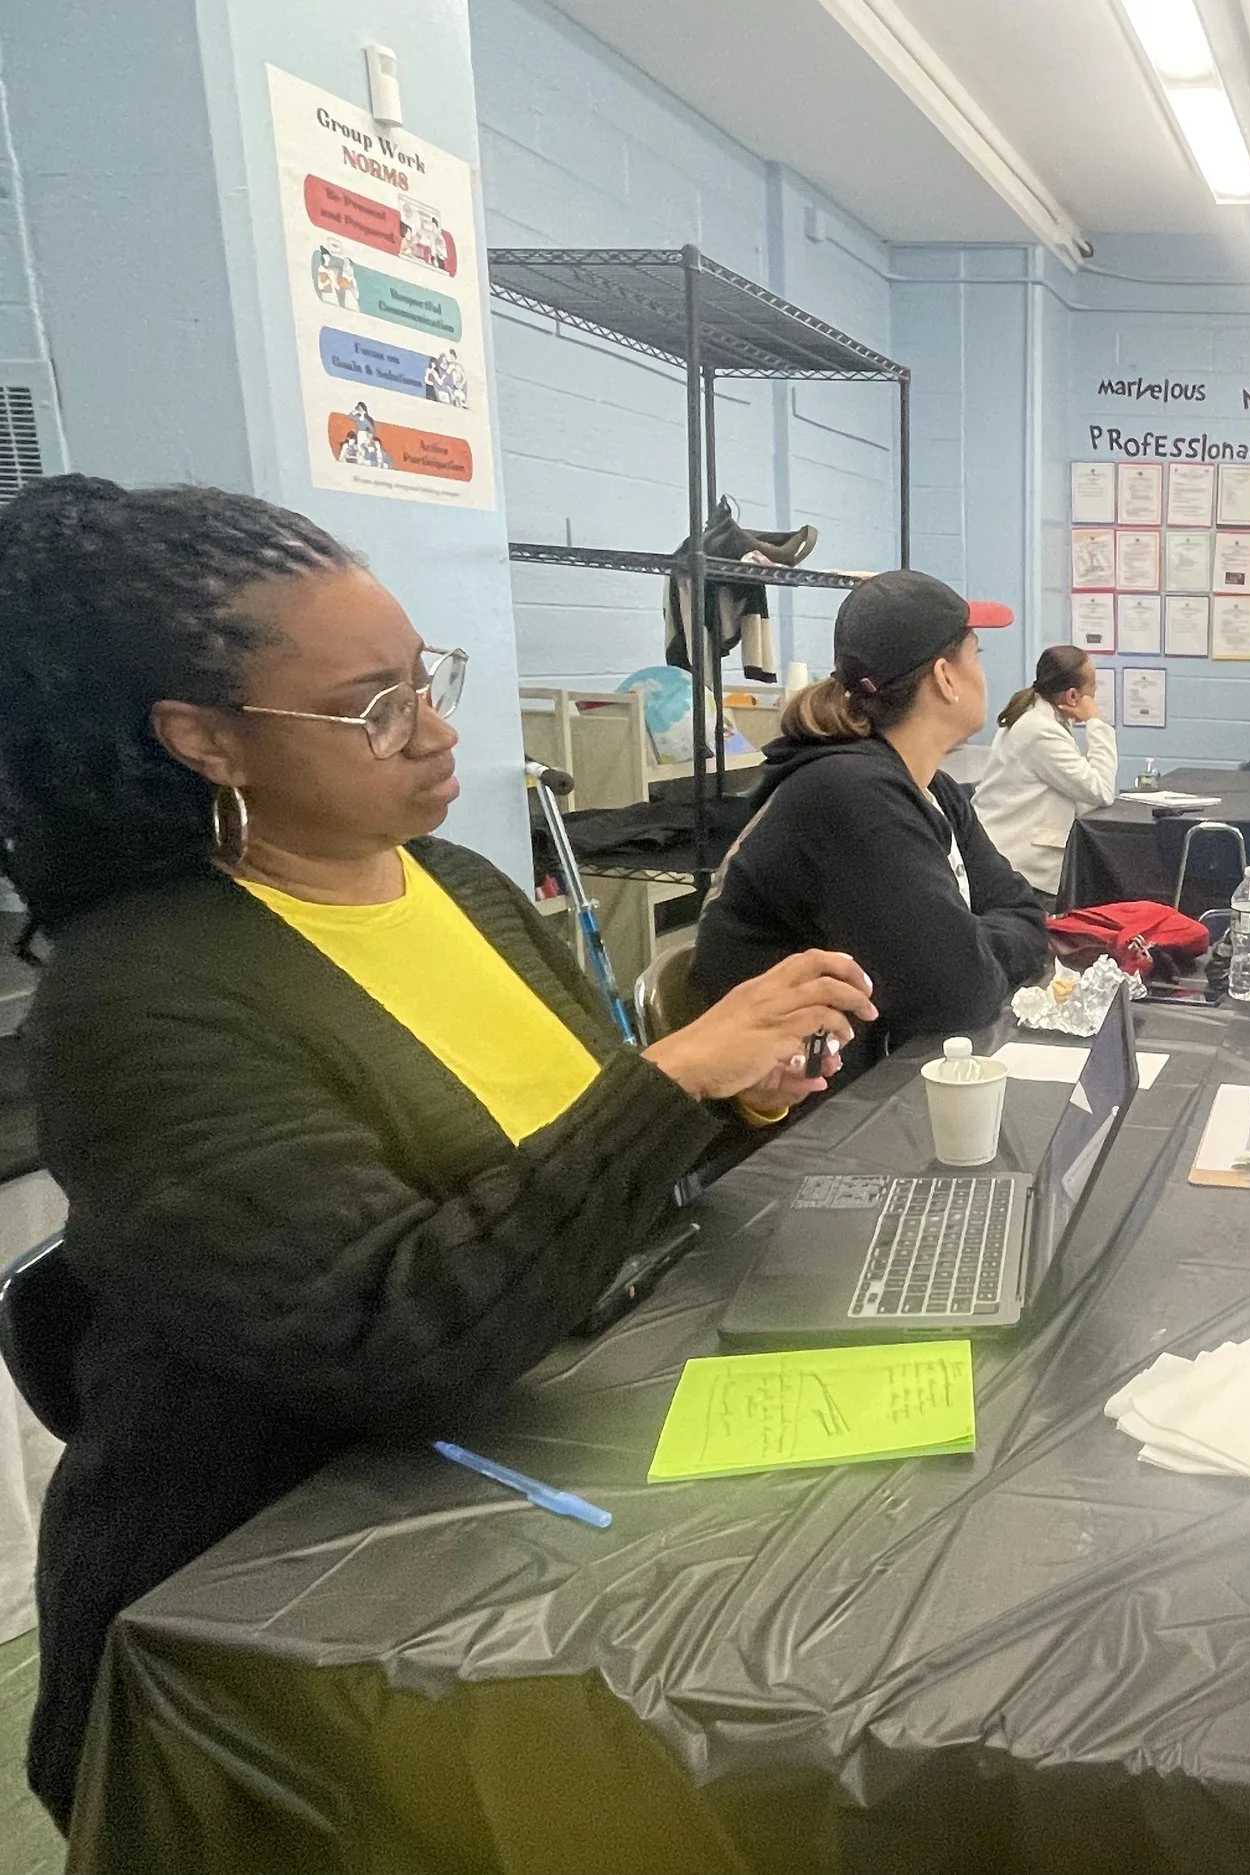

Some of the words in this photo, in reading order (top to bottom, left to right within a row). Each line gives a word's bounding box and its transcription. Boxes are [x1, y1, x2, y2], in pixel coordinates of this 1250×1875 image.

[316, 107, 373, 152] Group
[377, 136, 426, 174] Work
[342, 145, 409, 191] NORMS
